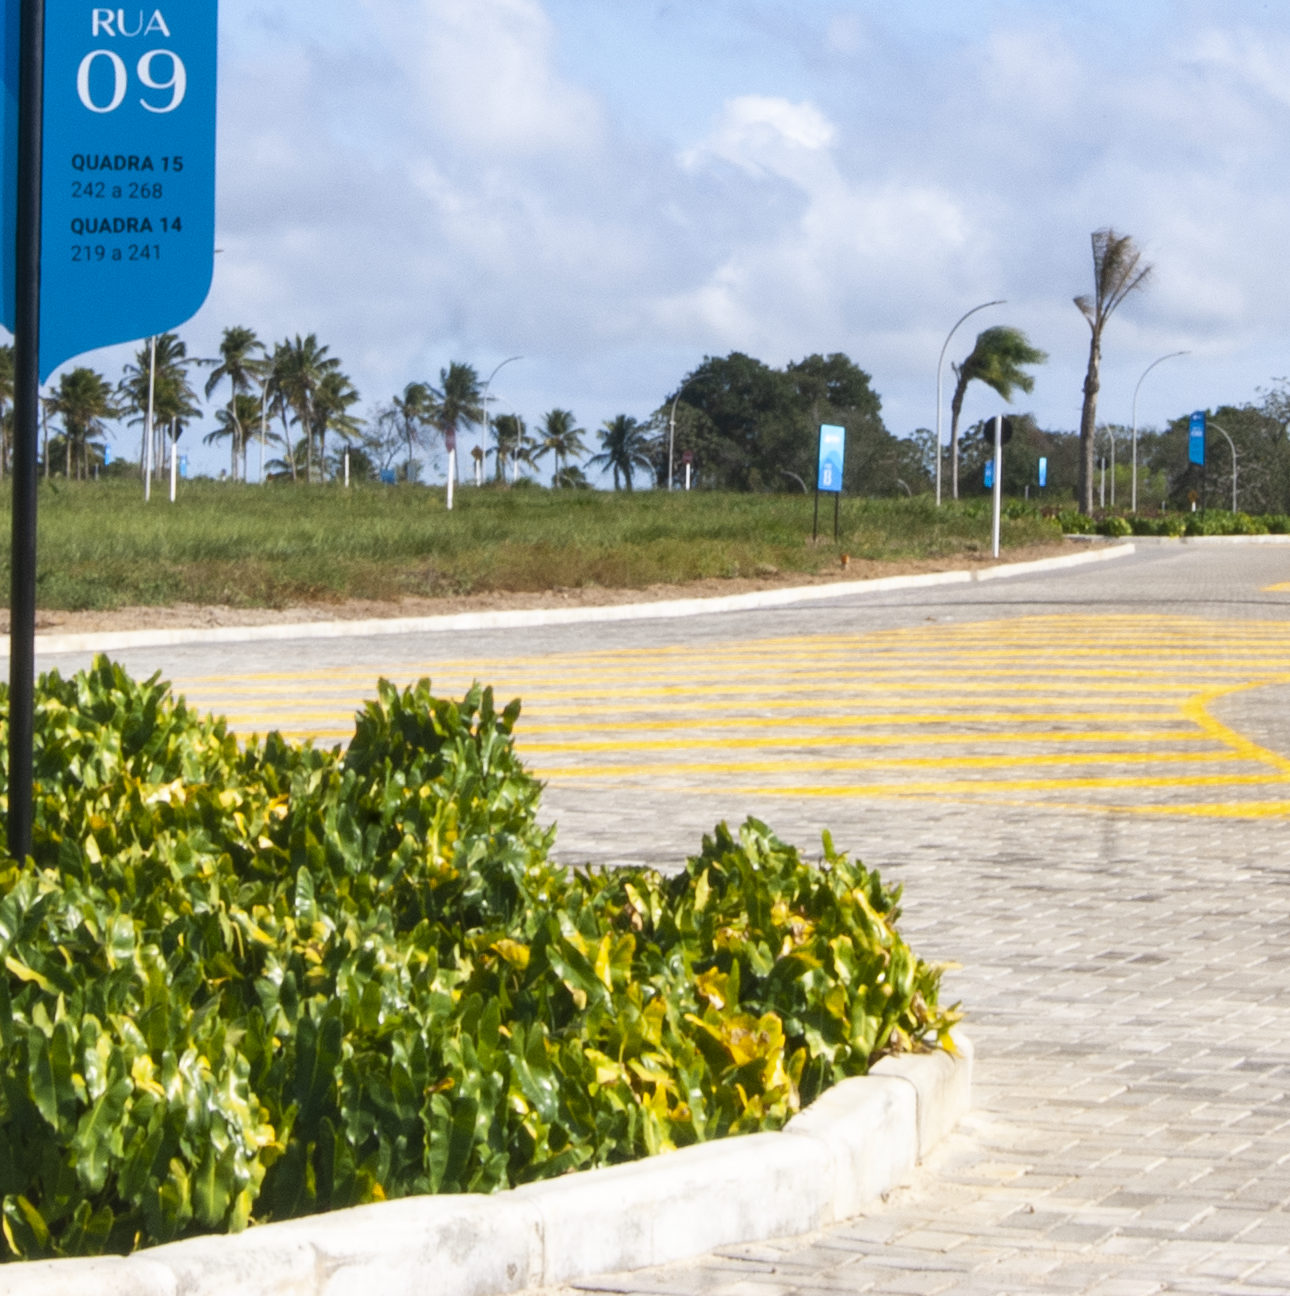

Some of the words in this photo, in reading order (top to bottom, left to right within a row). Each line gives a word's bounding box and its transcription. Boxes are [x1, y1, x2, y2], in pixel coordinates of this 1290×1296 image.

[91, 8, 171, 38] RUA
[76, 48, 187, 114] 09
[71, 154, 155, 172] QUADRA
[161, 155, 184, 172] 15
[71, 181, 106, 199] 242
[111, 185, 122, 199] a
[128, 181, 163, 200] 268
[70, 217, 153, 236] QUADRA
[160, 216, 183, 233] 14
[71, 244, 106, 262] 219
[111, 247, 123, 262] a
[127, 243, 160, 261] 241
